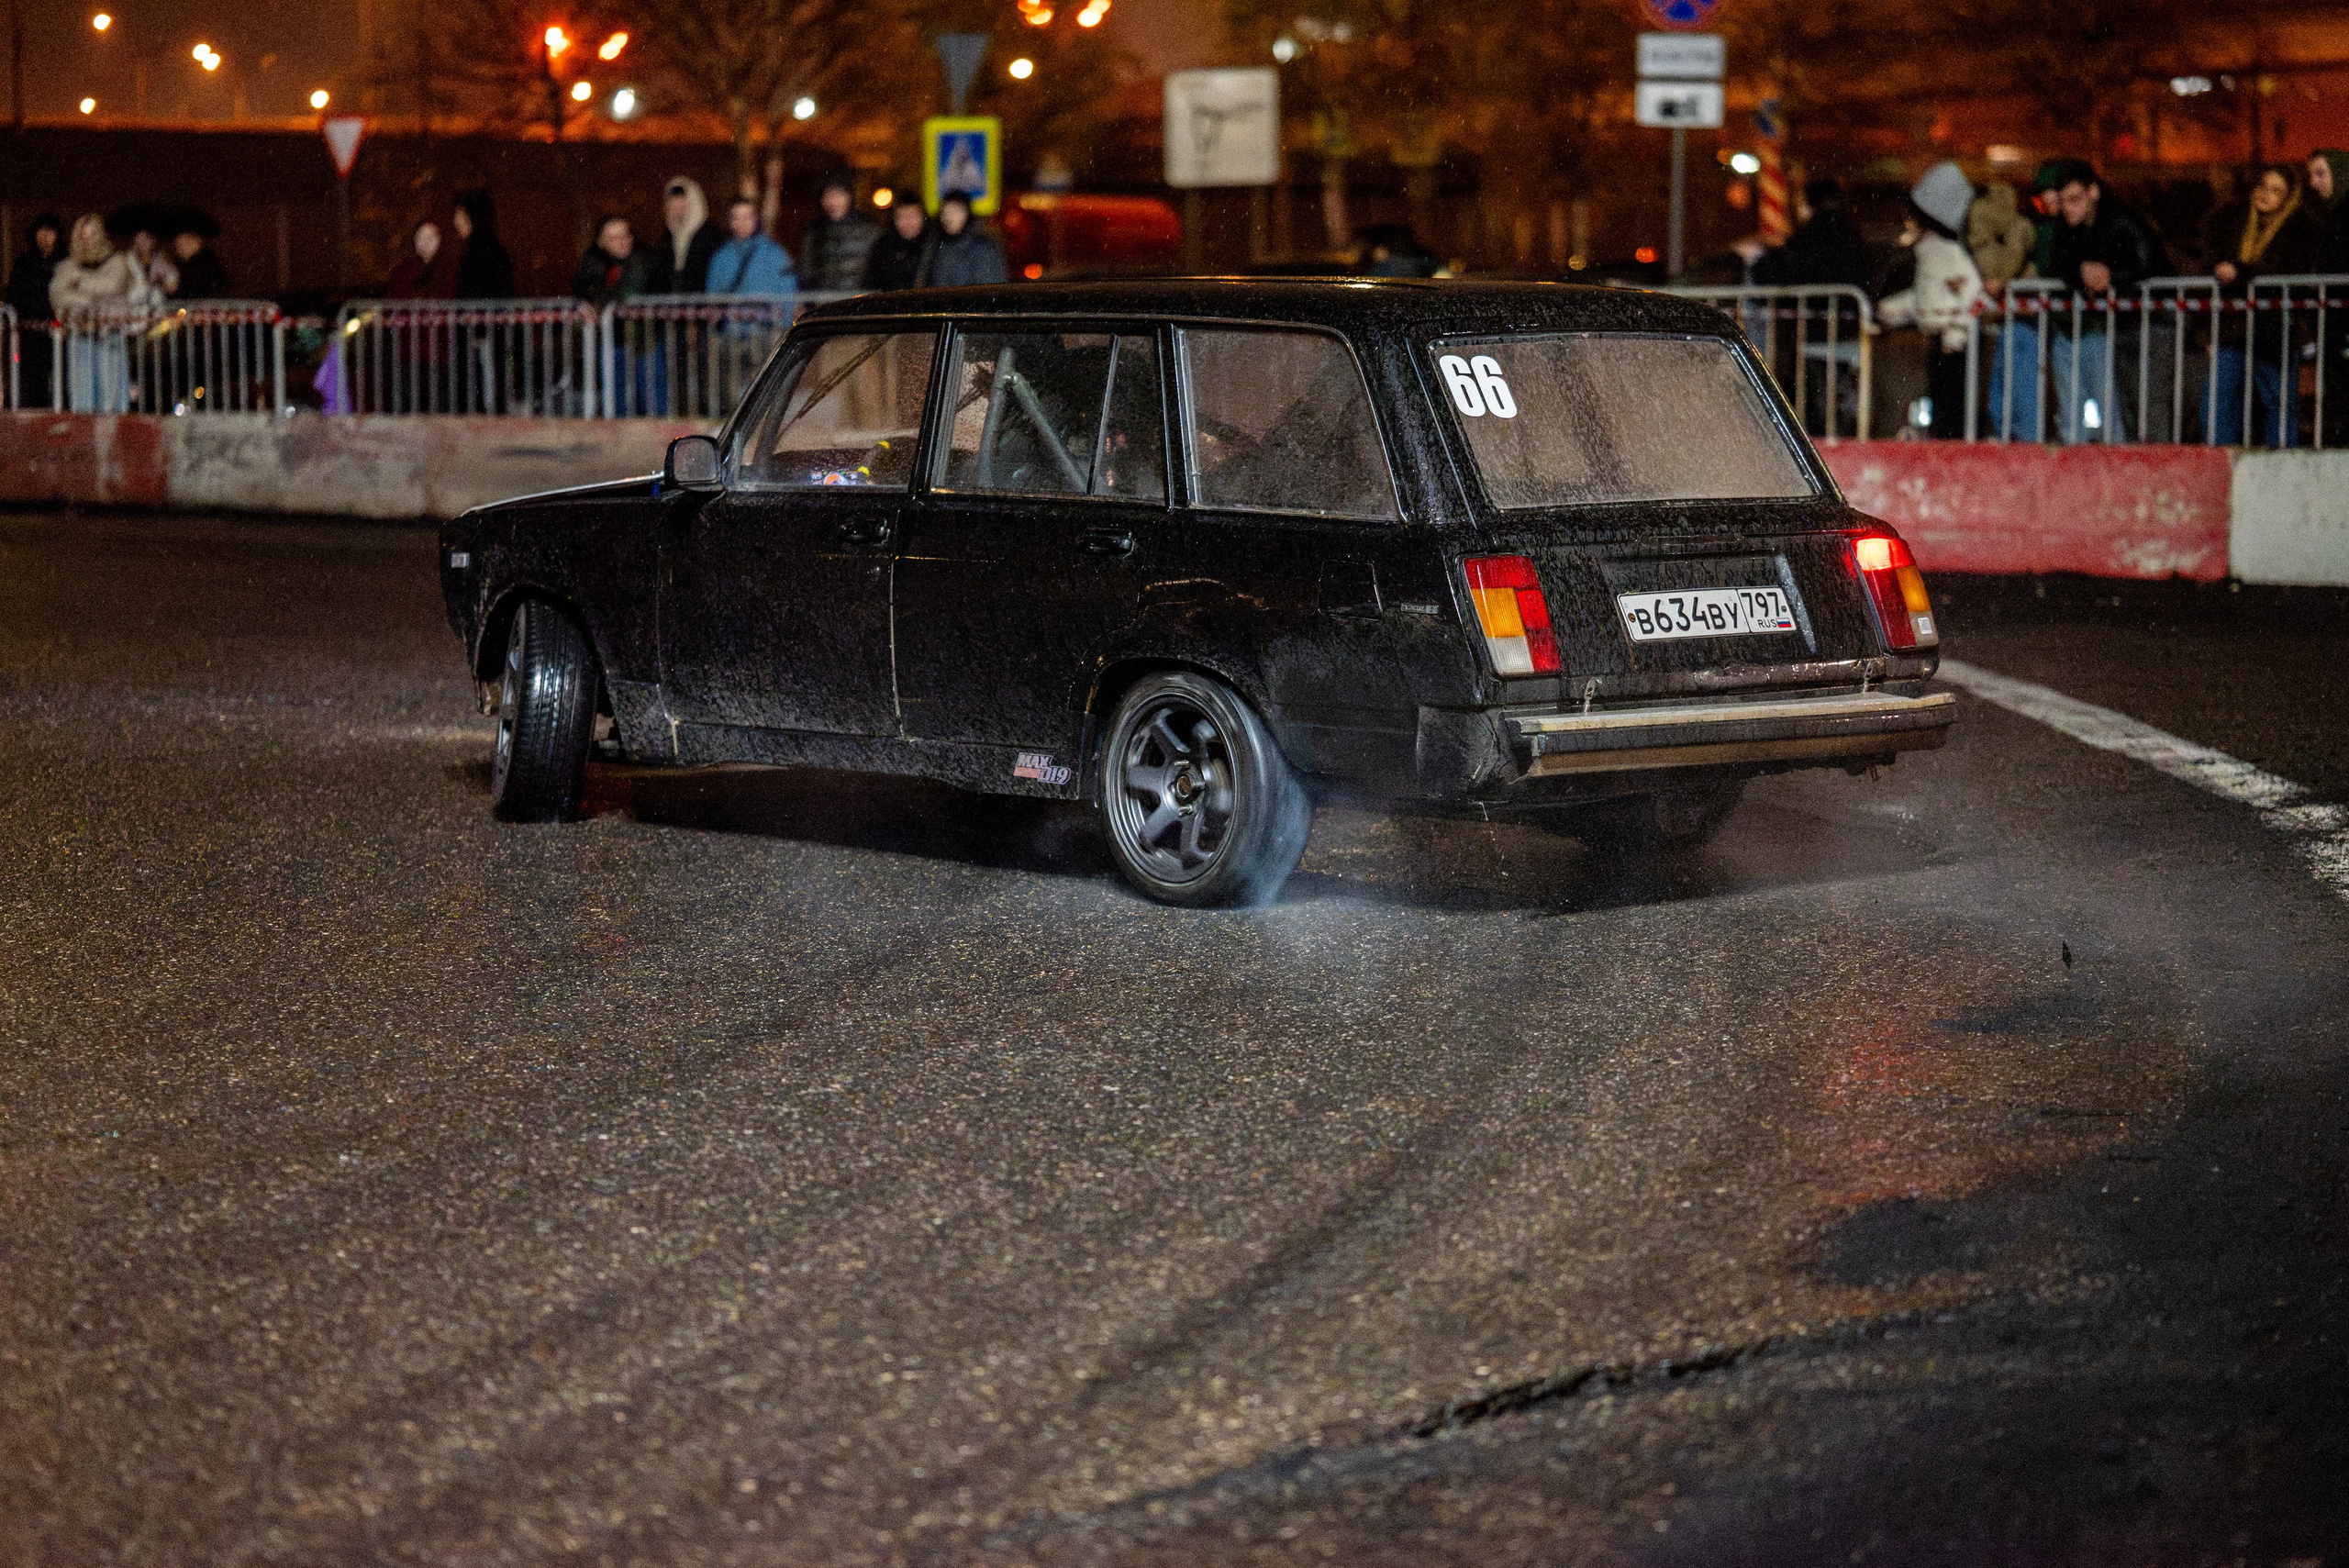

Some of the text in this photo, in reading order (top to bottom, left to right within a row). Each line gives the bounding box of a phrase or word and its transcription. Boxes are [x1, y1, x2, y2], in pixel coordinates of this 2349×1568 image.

[1439, 354, 1518, 418] 66
[1740, 592, 1780, 618] 797
[1758, 617, 1777, 628] RUS
[1018, 754, 1051, 768] MAX
